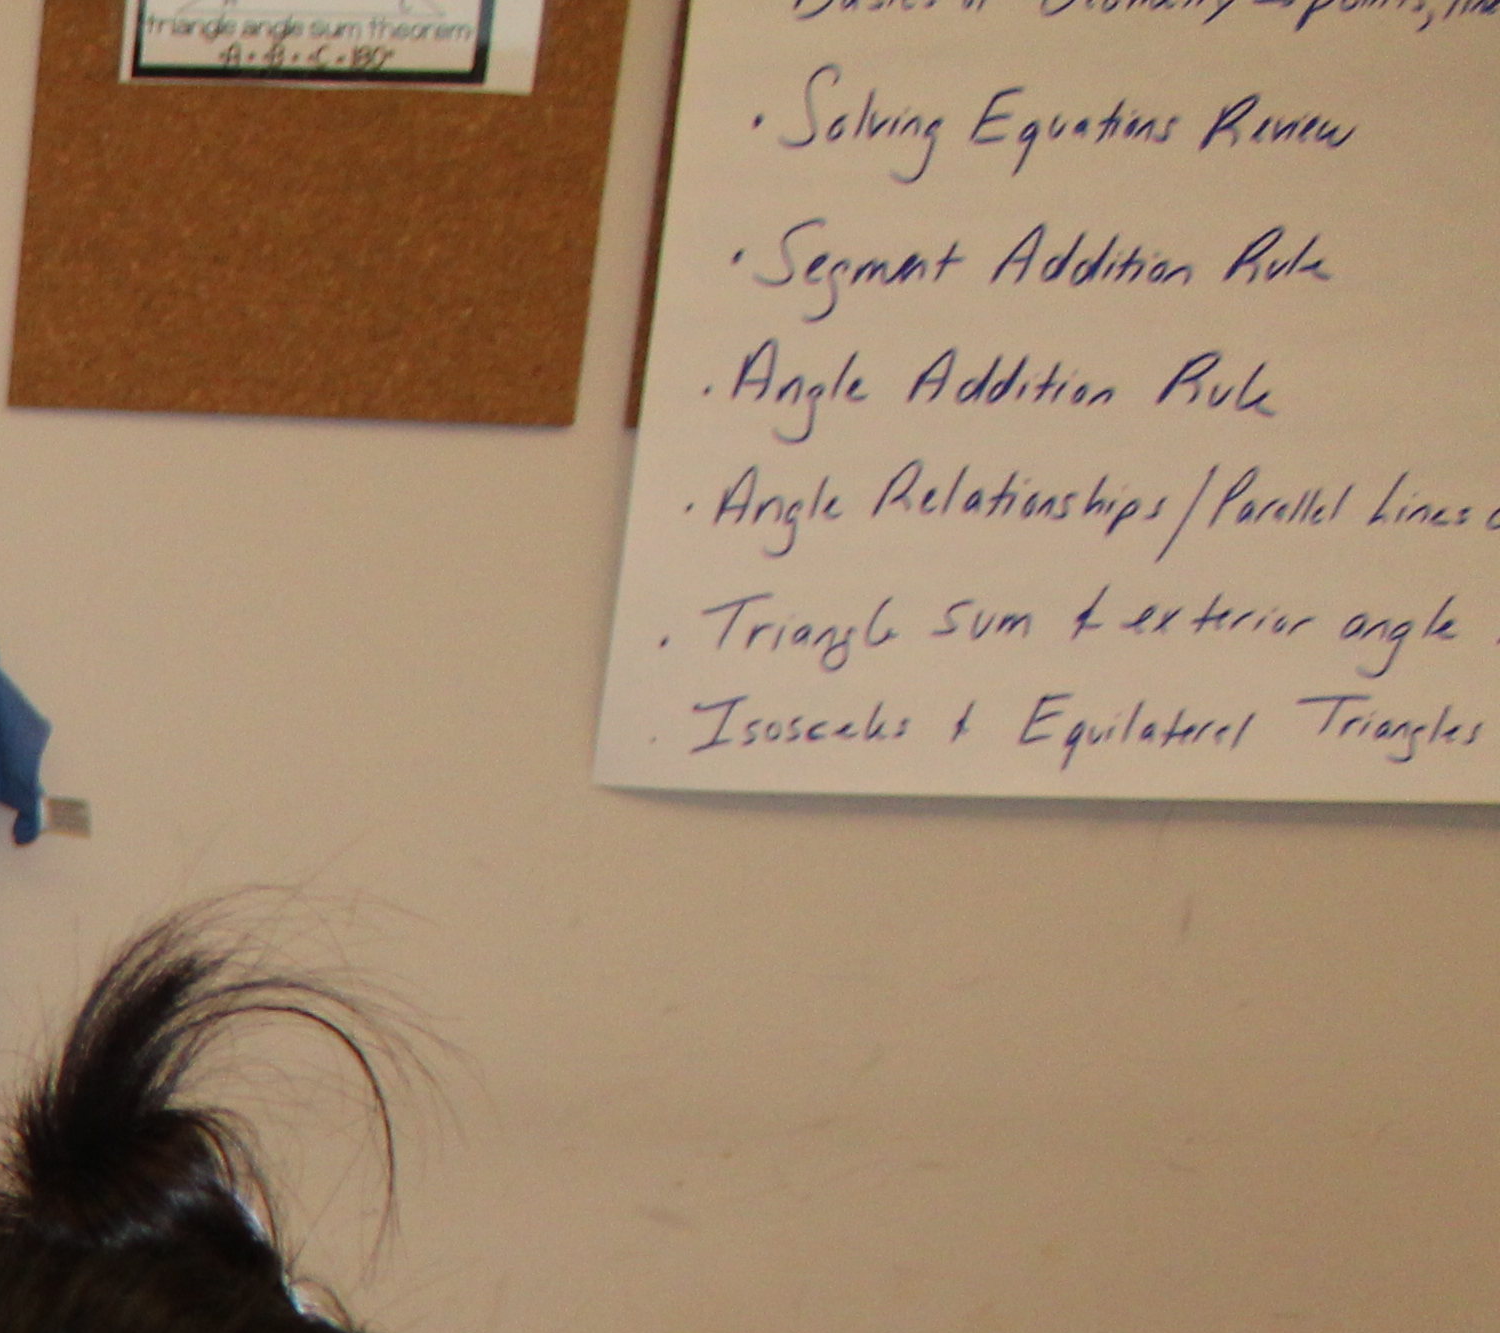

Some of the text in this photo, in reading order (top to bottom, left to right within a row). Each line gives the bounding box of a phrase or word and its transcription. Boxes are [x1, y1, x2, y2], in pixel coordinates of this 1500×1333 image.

[784, 62, 1356, 185] Solving Equations Review
[761, 217, 964, 323] Segment
[990, 223, 1193, 287] Addition
[731, 338, 868, 445] Angle
[907, 348, 1115, 406] Addition
[713, 464, 842, 558] Angle
[1367, 471, 1472, 526] Lines
[701, 591, 899, 673] Triangle
[1340, 595, 1457, 679] angle
[1297, 694, 1484, 764] Triangles
